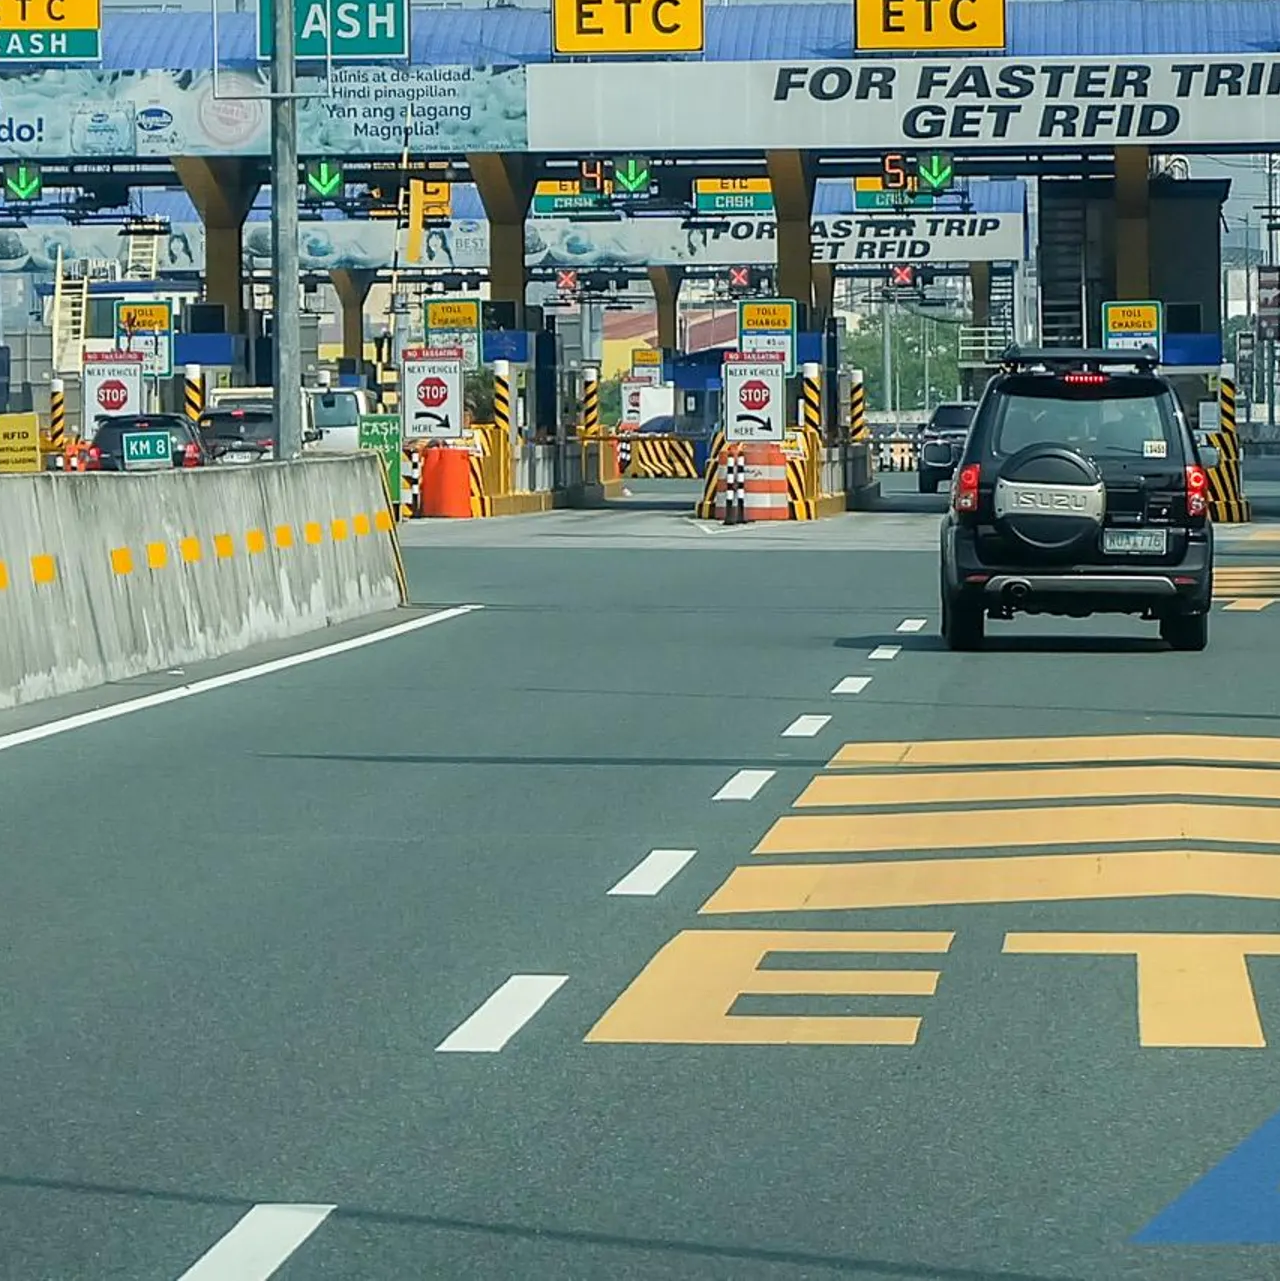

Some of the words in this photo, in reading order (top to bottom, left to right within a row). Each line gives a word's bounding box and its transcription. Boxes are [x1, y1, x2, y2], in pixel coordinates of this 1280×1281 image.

[295, 3, 395, 38] ASH
[372, 70, 388, 84] at
[391, 68, 475, 83] de-kalidad.
[773, 66, 897, 101] FOR
[918, 64, 1151, 99] FASTER
[332, 86, 370, 99] Hindi
[362, 107, 395, 121] ang
[400, 102, 471, 122] alagang
[902, 104, 1023, 138] GET
[1038, 104, 1181, 138] RFID
[354, 122, 439, 140] Magnolia!
[582, 160, 601, 191] 4
[883, 154, 904, 188] 5
[715, 196, 754, 208] CASH
[812, 219, 917, 238] ASTER
[926, 218, 1000, 236] TRIP
[455, 238, 485, 249] BEST
[812, 243, 845, 259] ET
[855, 240, 930, 259] RFID
[746, 319, 788, 328] CHARGES
[98, 389, 127, 402] STOP
[418, 386, 447, 399] STOP
[740, 389, 769, 402] STOP
[2, 431, 29, 440] RFID
[361, 421, 399, 435] CASH
[129, 440, 151, 455] KM
[156, 439, 166, 454] 8
[1012, 491, 1087, 511] ISUZU
